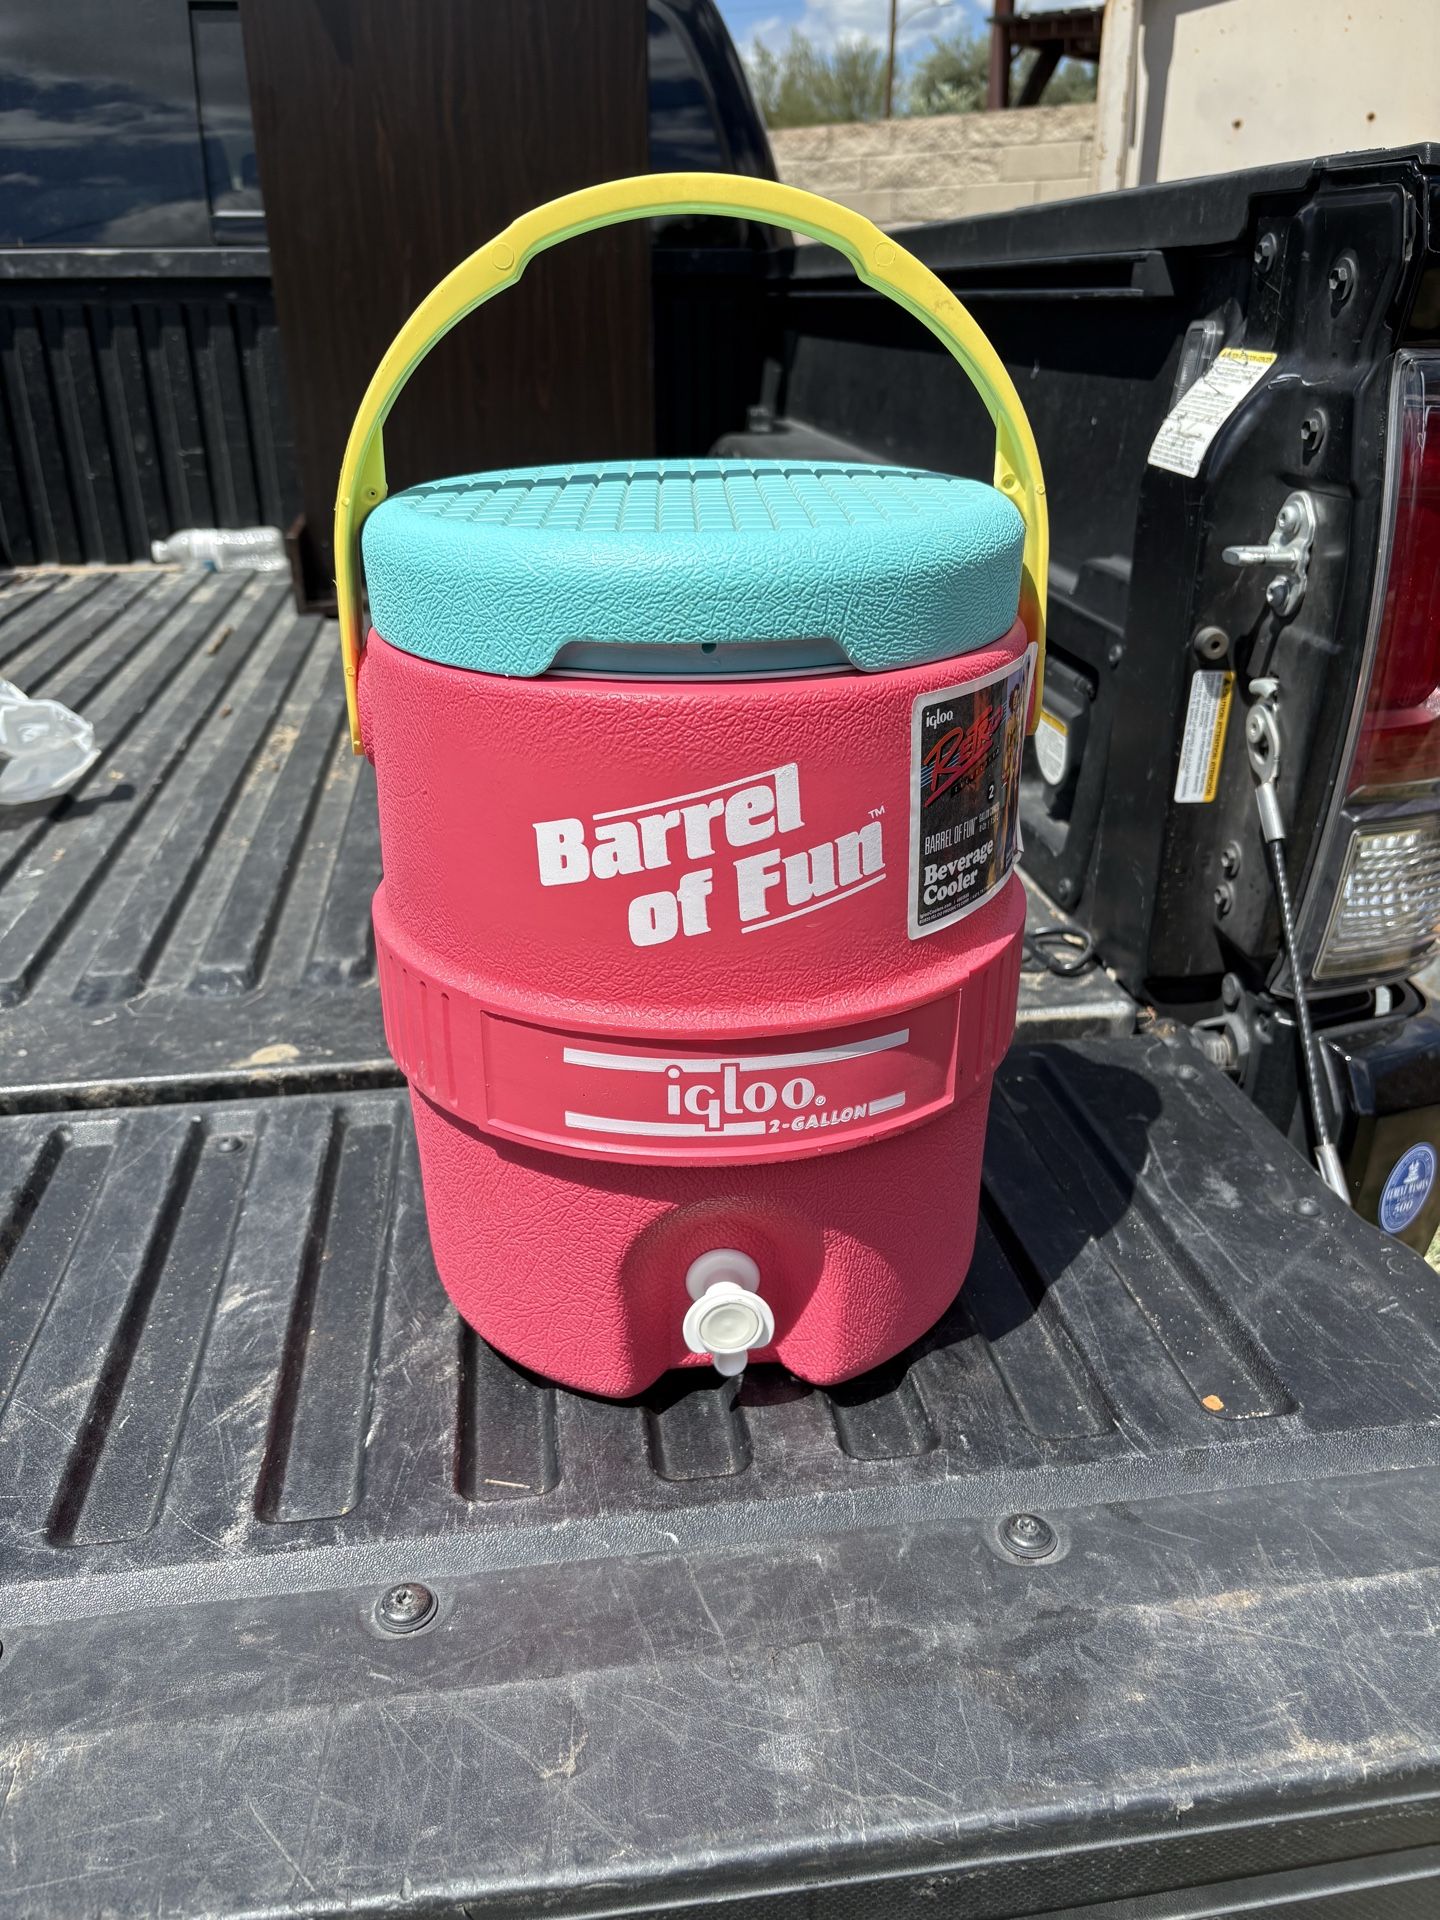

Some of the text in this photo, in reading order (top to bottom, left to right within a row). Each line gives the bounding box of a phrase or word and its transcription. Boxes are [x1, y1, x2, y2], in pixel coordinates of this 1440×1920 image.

[926, 707, 954, 729] igloo
[988, 784, 995, 800] 2
[532, 762, 805, 887] Barrel
[924, 828, 953, 856] BARREL
[954, 823, 963, 844] OF
[963, 818, 976, 841] FUN
[924, 839, 994, 886] Beverage
[628, 868, 713, 947] of
[733, 821, 886, 922] Fun
[923, 868, 978, 906] Cooler
[667, 1065, 816, 1128] igloo
[768, 1103, 868, 1134] 2-GALLON
